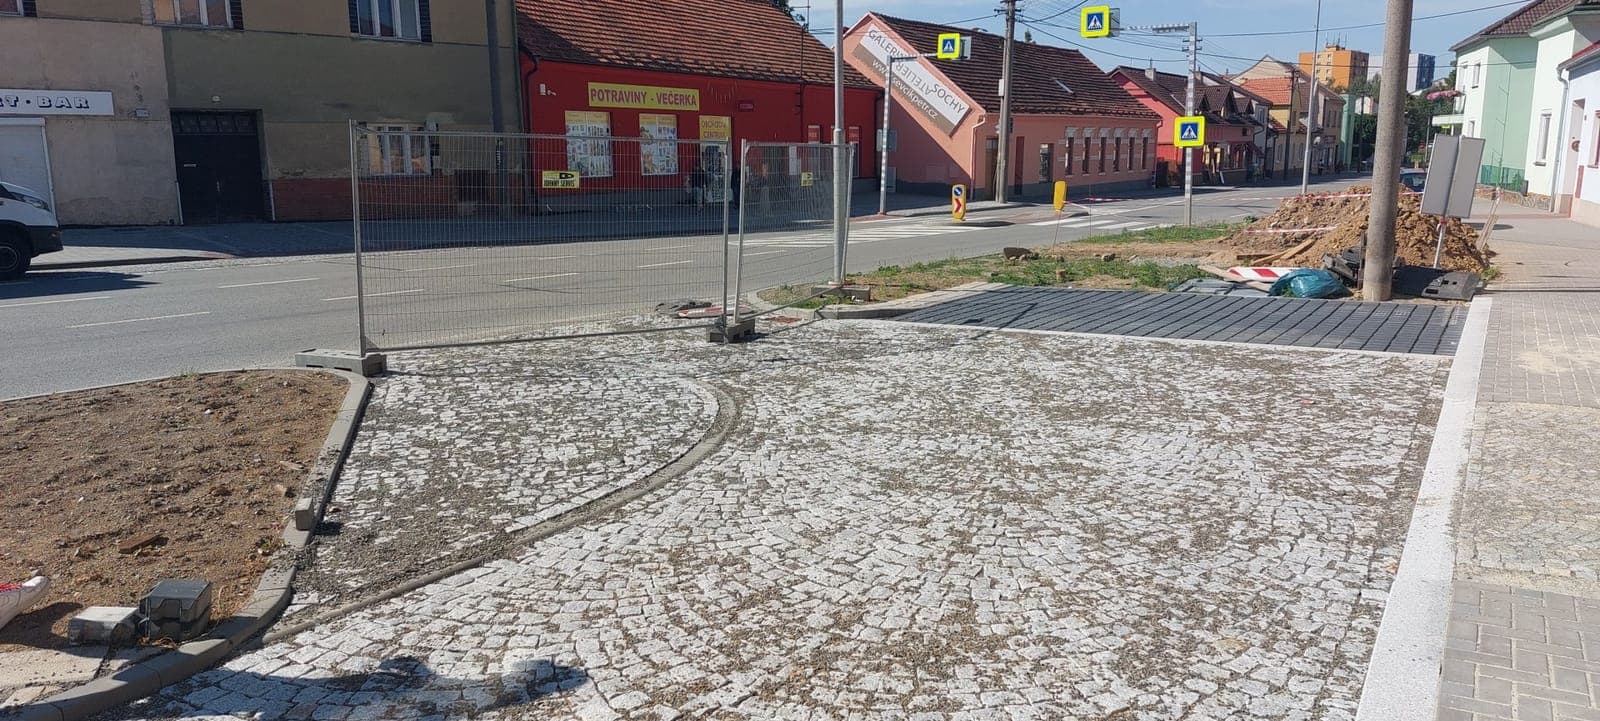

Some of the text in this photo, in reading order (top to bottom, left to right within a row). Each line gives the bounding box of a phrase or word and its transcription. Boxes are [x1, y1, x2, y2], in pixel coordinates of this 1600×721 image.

[37, 95, 90, 109] BAR
[590, 88, 647, 104] POTRAVINY
[656, 90, 697, 106] VEČERKA
[931, 83, 965, 115] SOCHY
